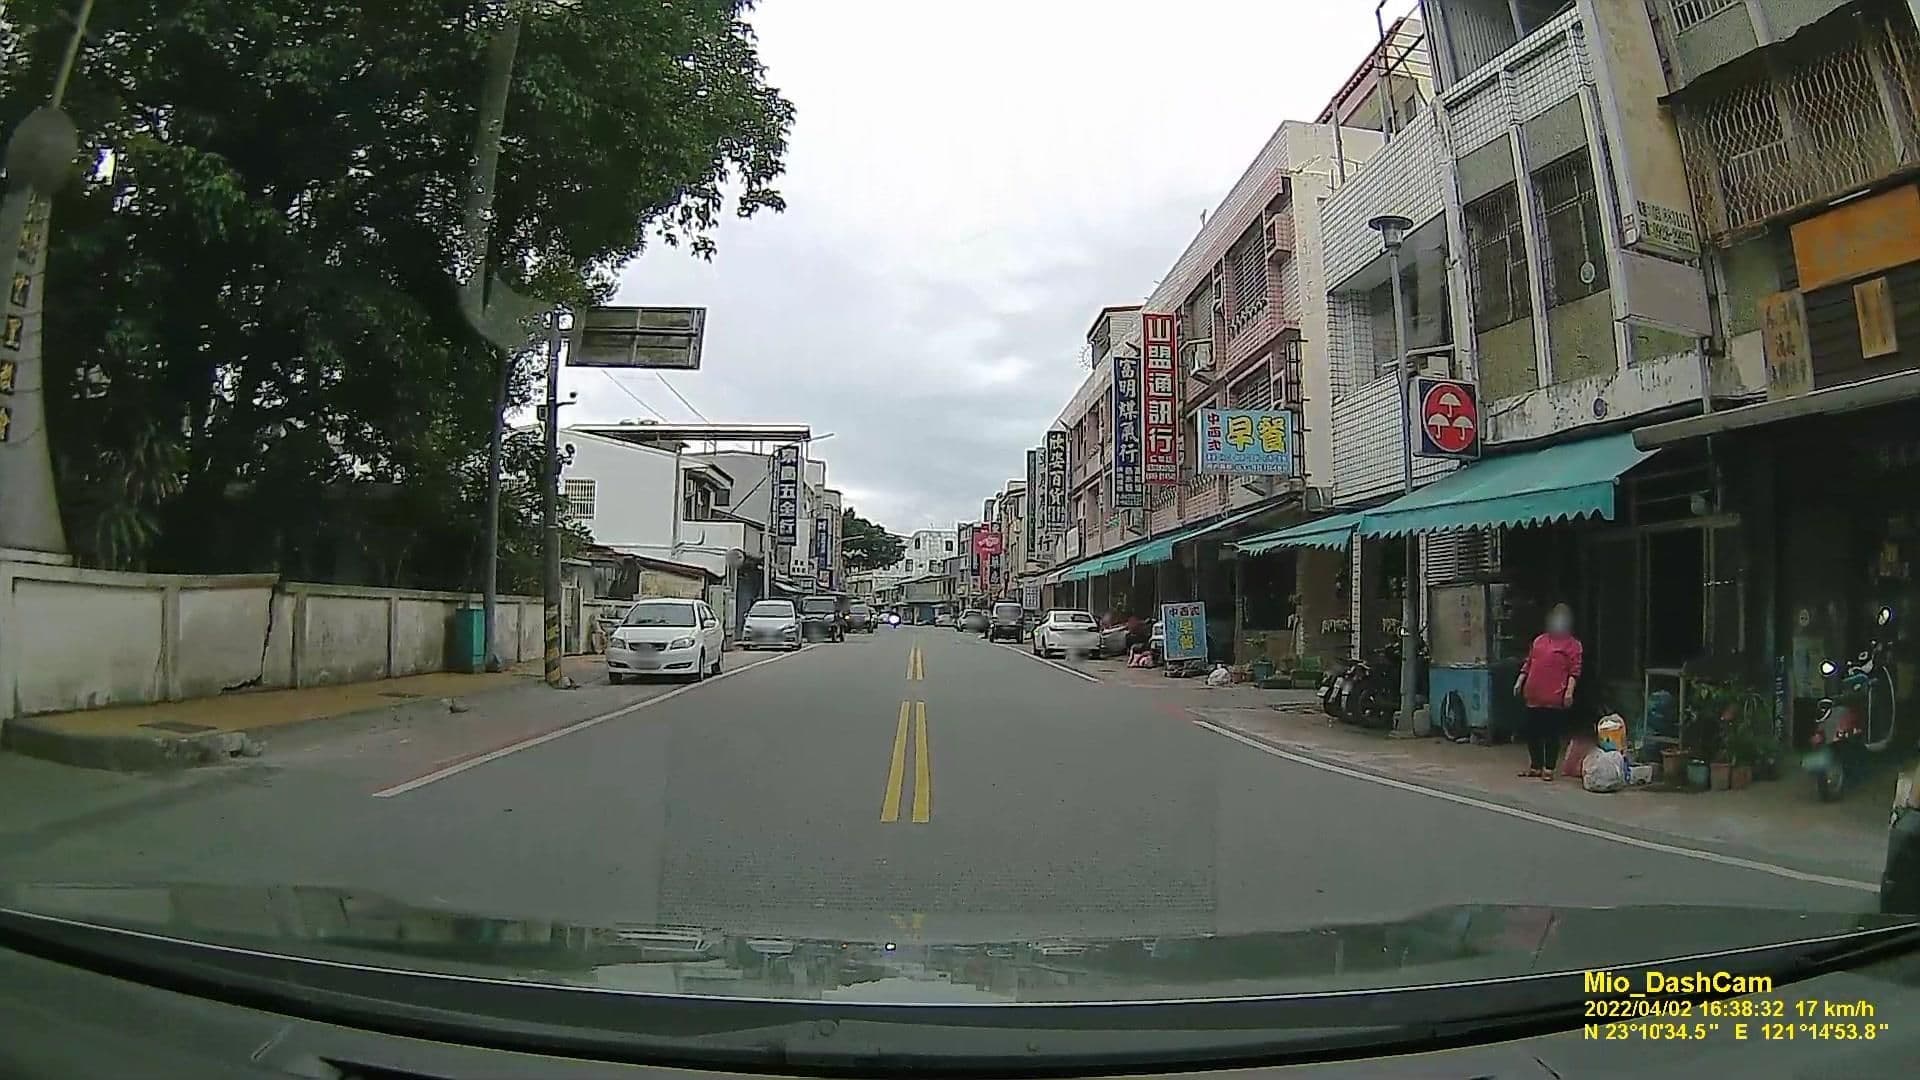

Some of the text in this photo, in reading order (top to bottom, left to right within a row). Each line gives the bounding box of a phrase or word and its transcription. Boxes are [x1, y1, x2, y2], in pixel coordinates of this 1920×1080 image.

[1147, 318, 1173, 453] 山盟通訊行
[1225, 415, 1286, 453] 早餐
